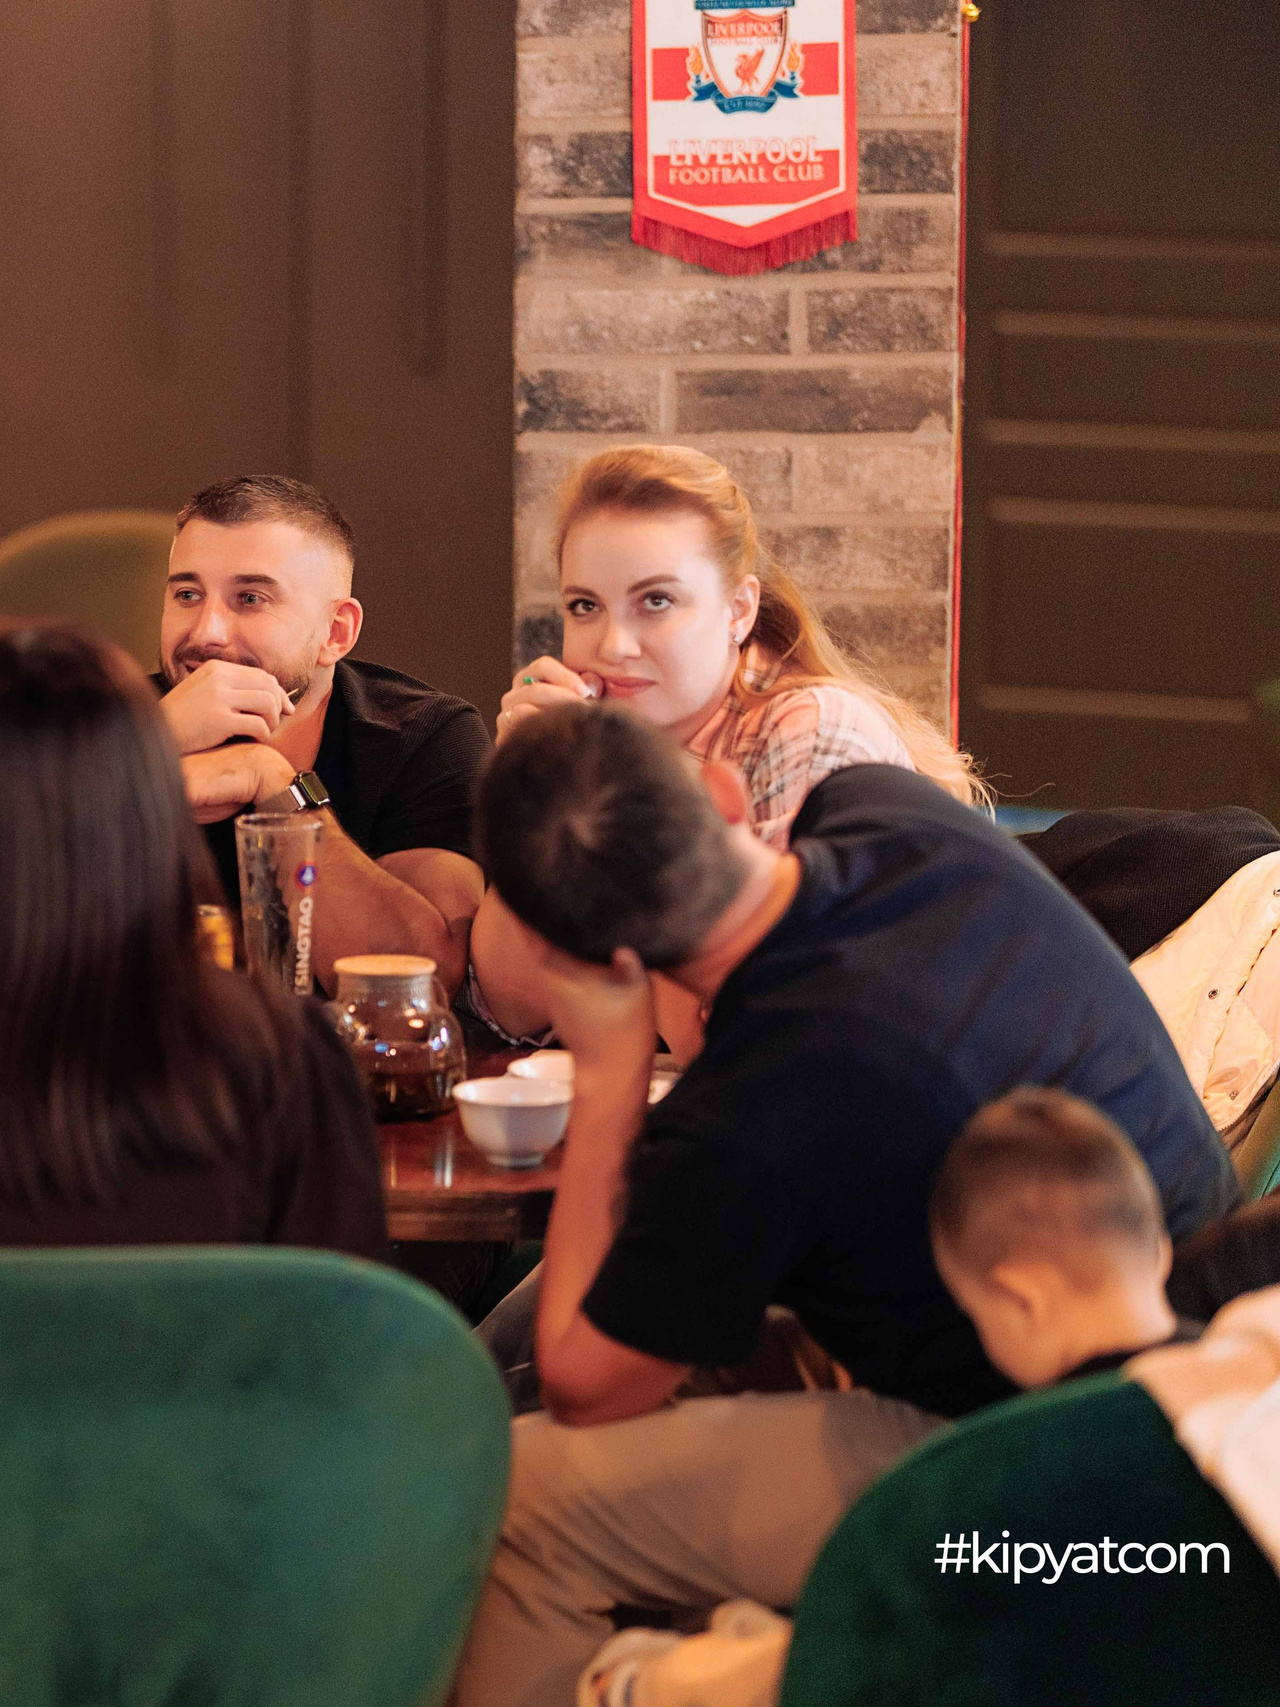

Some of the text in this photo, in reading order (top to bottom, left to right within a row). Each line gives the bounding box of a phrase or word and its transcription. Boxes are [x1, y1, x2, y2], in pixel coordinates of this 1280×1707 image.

[707, 21, 781, 37] LIVERPOOL
[668, 136, 823, 166] LIVERPOOL
[669, 164, 824, 185] FOOTBALL CLUB
